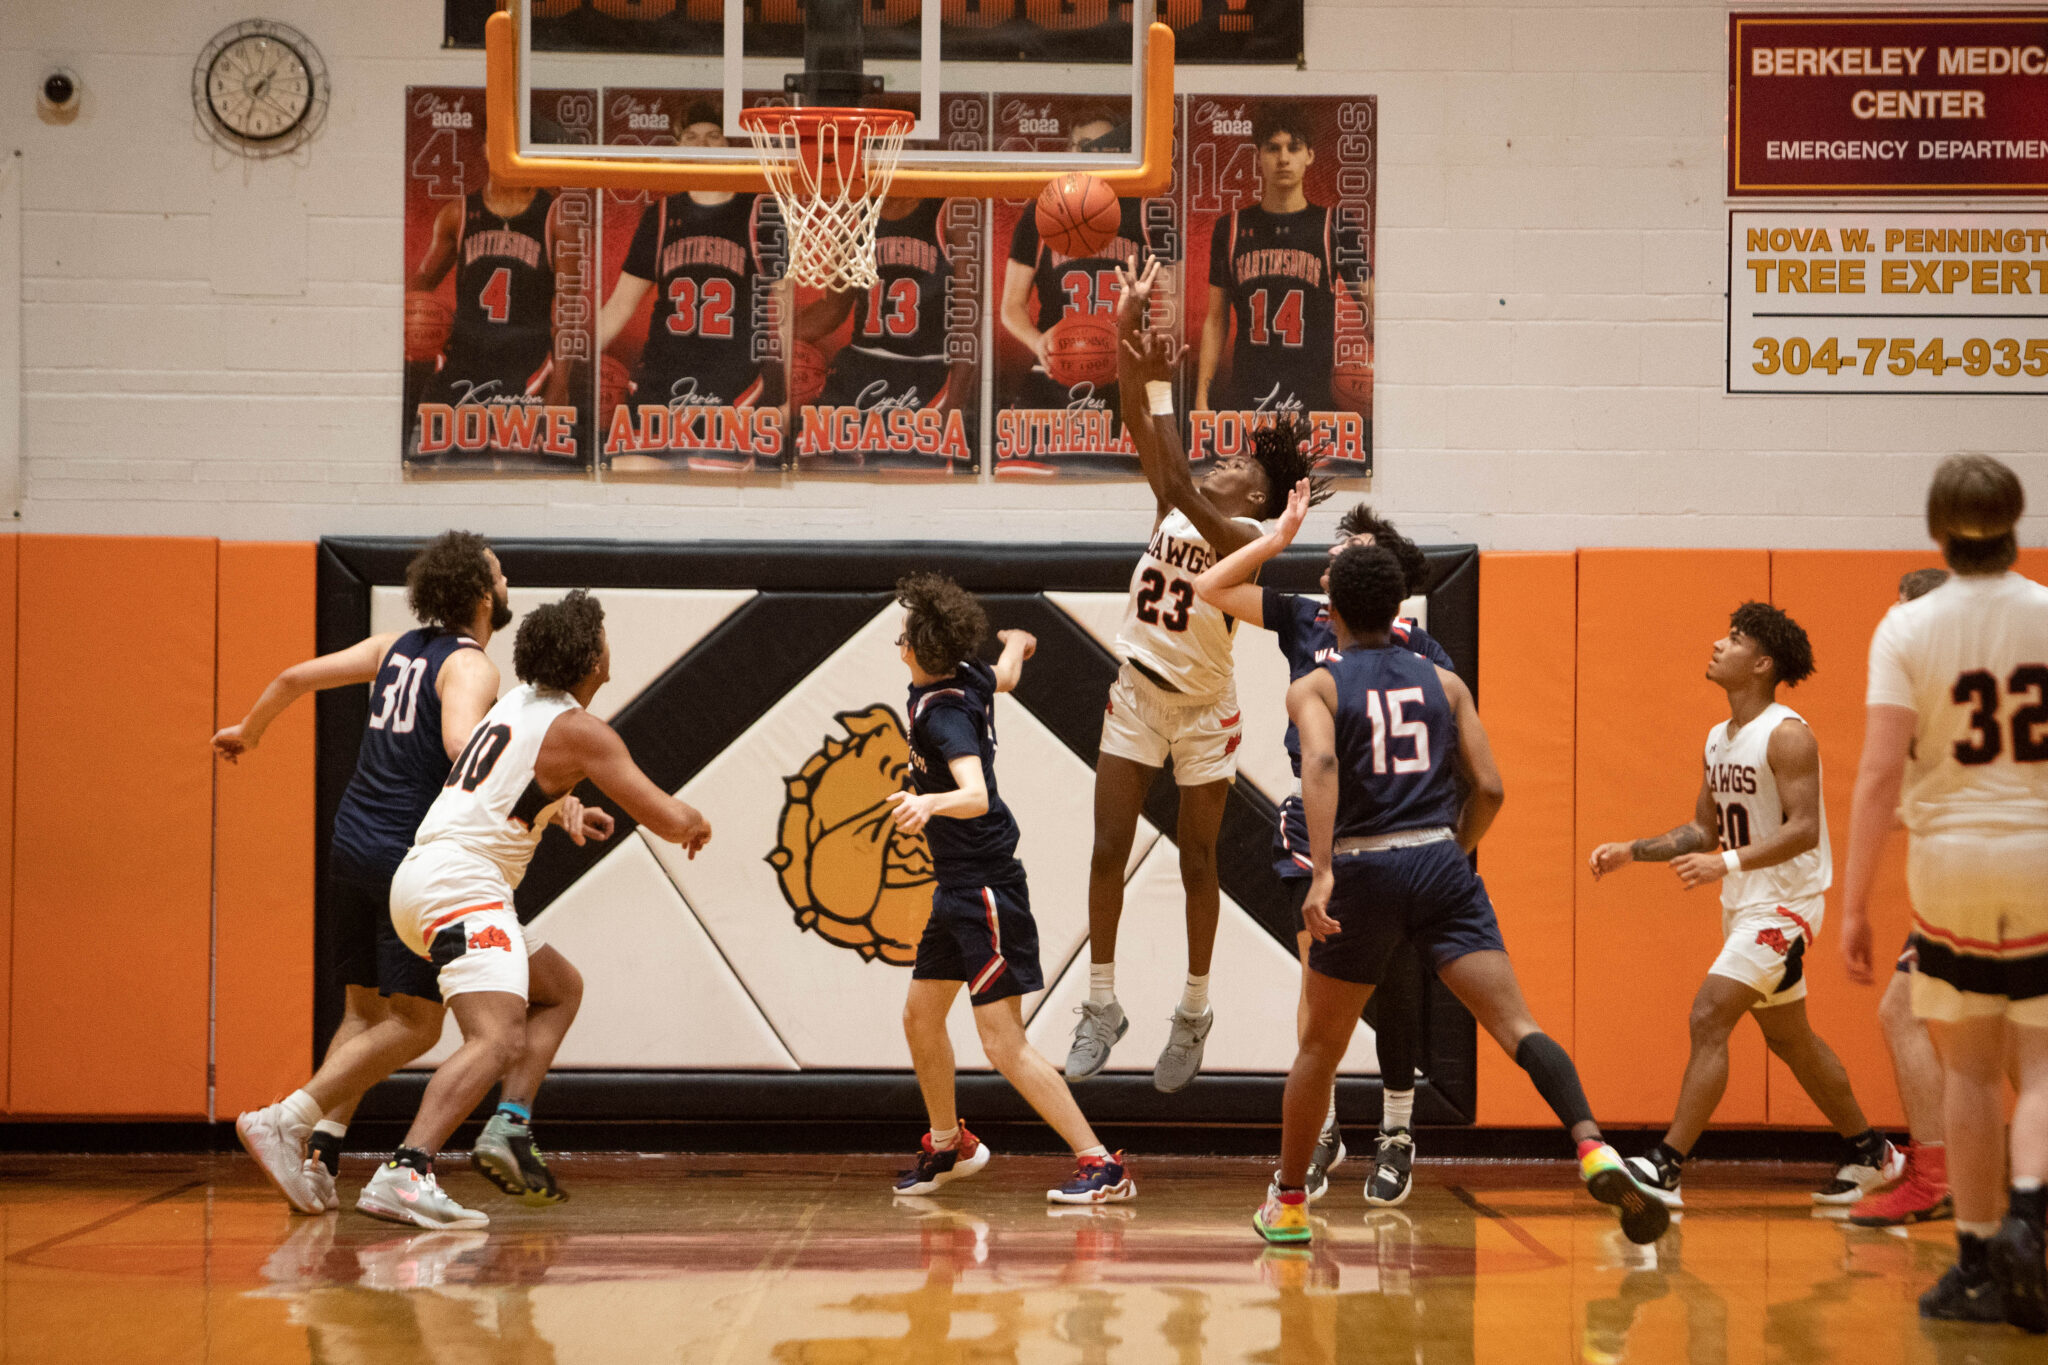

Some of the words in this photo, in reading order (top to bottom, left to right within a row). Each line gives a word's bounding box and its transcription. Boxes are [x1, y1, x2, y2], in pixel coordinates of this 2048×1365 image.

[1751, 47, 1927, 76] BERKELEY
[1938, 46, 2048, 76] MEDIC
[431, 111, 473, 128] 2022
[628, 113, 670, 129] 2022
[1018, 118, 1060, 134] 2022
[1212, 119, 1253, 136] 2022
[1851, 90, 1986, 119] CENTER
[412, 129, 465, 198] 4
[1766, 140, 1909, 160] EMERGENCY
[1192, 143, 1262, 212] 14
[874, 235, 939, 275] TINSBURG
[1335, 102, 1372, 366] BULLDOGS
[1746, 228, 1833, 252] NOVA
[1840, 228, 1875, 252] W.
[1885, 228, 2048, 253] PENNINGT
[1236, 249, 1322, 288] MARTINSBURG
[1746, 258, 1866, 294] TREE
[1881, 259, 2048, 294] EXPERT
[479, 268, 512, 323] 4
[666, 277, 736, 339] 32
[863, 277, 921, 337] 13
[1249, 288, 1305, 347] 14
[1752, 337, 2048, 377] 304-754-935
[1067, 380, 1106, 420] Jess
[1253, 381, 1304, 413] Luke
[417, 403, 578, 457] DOWE
[604, 404, 783, 457] ADKINS
[800, 405, 972, 459] NGASSA
[996, 408, 1139, 459] SUTHERLA
[1146, 530, 1212, 575] AWGS
[1136, 567, 1195, 633] 23
[368, 652, 428, 733] 30
[1951, 663, 2048, 766] 32
[1366, 686, 1431, 775] 15
[444, 720, 513, 793] 10
[1706, 763, 1757, 795] AWGS
